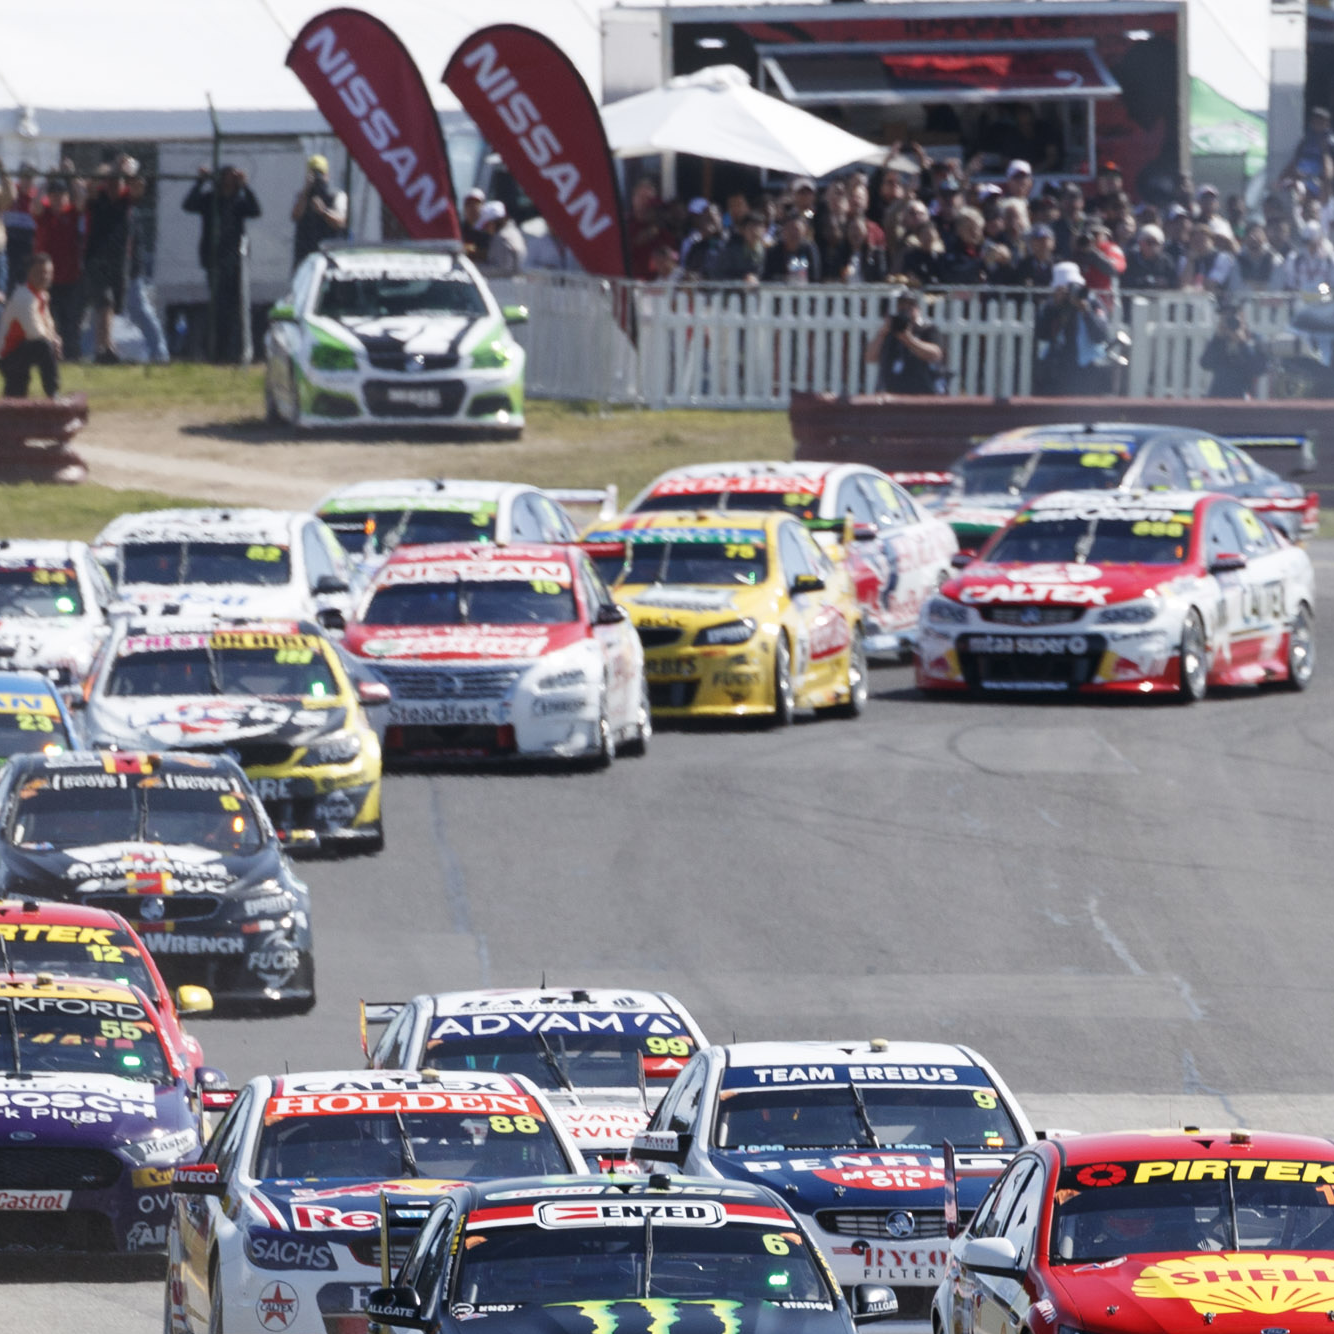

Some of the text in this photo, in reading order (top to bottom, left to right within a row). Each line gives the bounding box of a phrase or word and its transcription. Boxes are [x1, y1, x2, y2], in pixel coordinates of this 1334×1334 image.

[304, 23, 451, 225] NISSAN
[462, 42, 614, 241] NISSAN
[387, 563, 562, 580] NISSAN
[960, 583, 1113, 606] CALTEX
[17, 713, 55, 734] 23
[85, 944, 125, 964] 12
[249, 949, 300, 971] FUCHS
[100, 1019, 143, 1041] 55
[431, 1012, 625, 1039] ADVAM
[645, 1036, 690, 1056] 99
[753, 1066, 958, 1083] TEAM EREBUS
[292, 1080, 503, 1093] CALTEX
[271, 1093, 529, 1115] HOLDEN
[972, 1091, 998, 1110] 9
[30, 1106, 113, 1124] Plugs
[488, 1115, 541, 1135] 88
[743, 1153, 946, 1174] PENRI
[173, 1169, 217, 1183] IVECO
[870, 1177, 921, 1188] OIL
[601, 1205, 707, 1219] ENZED
[251, 1238, 333, 1270] SACHS
[762, 1233, 790, 1256] 6
[863, 1248, 947, 1270] RYCO
[260, 1303, 295, 1314] CALTEX
[367, 1303, 416, 1318] ALLGATE
